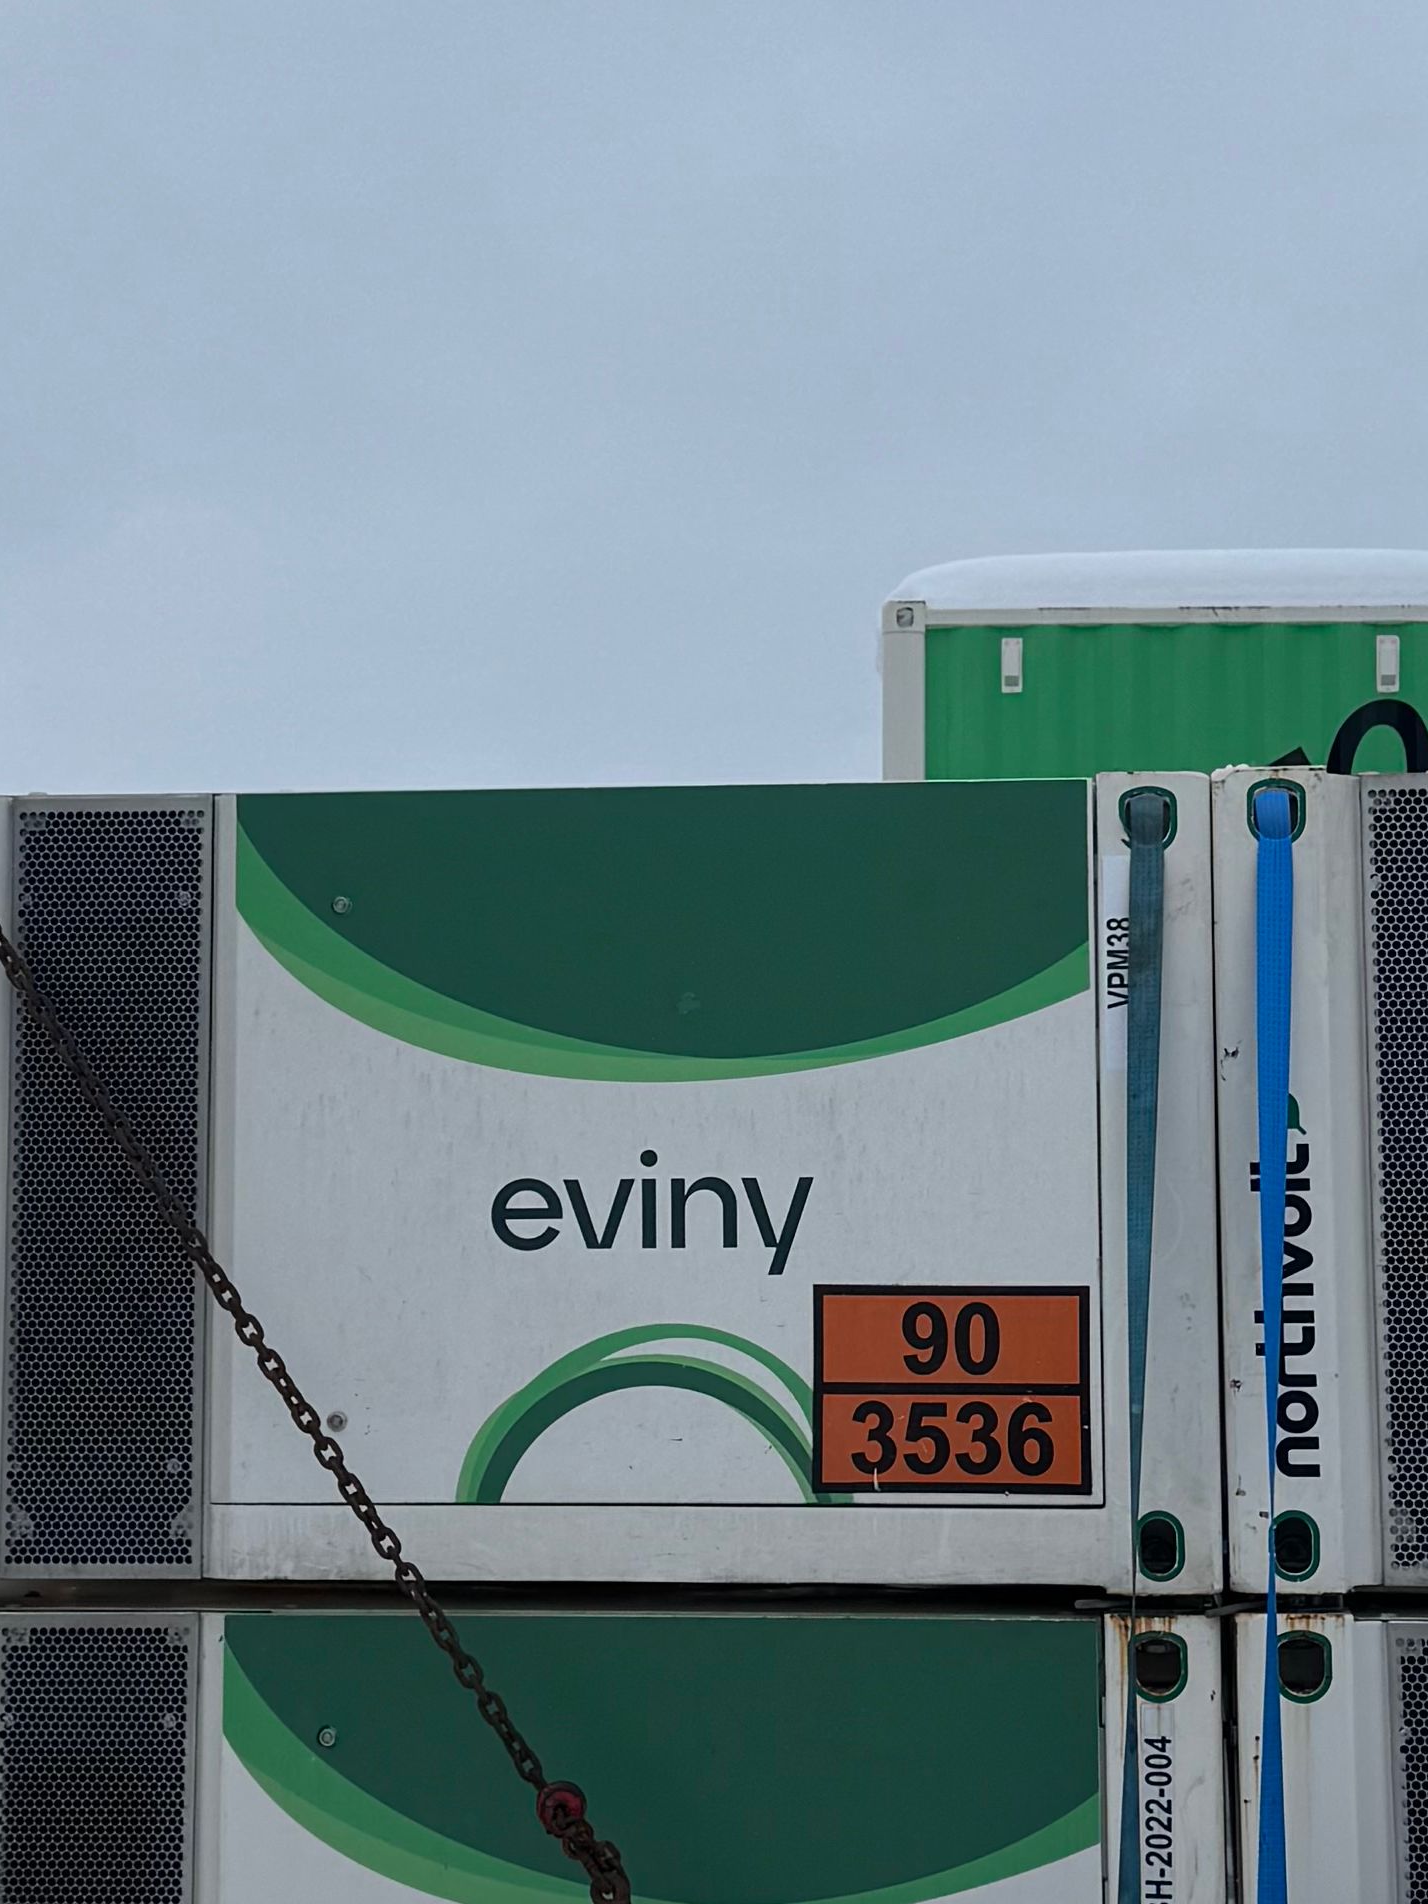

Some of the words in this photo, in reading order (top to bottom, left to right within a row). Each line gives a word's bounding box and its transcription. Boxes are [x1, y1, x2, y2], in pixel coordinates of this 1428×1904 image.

[1106, 917, 1130, 1009] VPM38
[490, 1149, 814, 1276] eviny
[901, 1301, 1001, 1376] 90
[850, 1400, 1055, 1477] 3536
